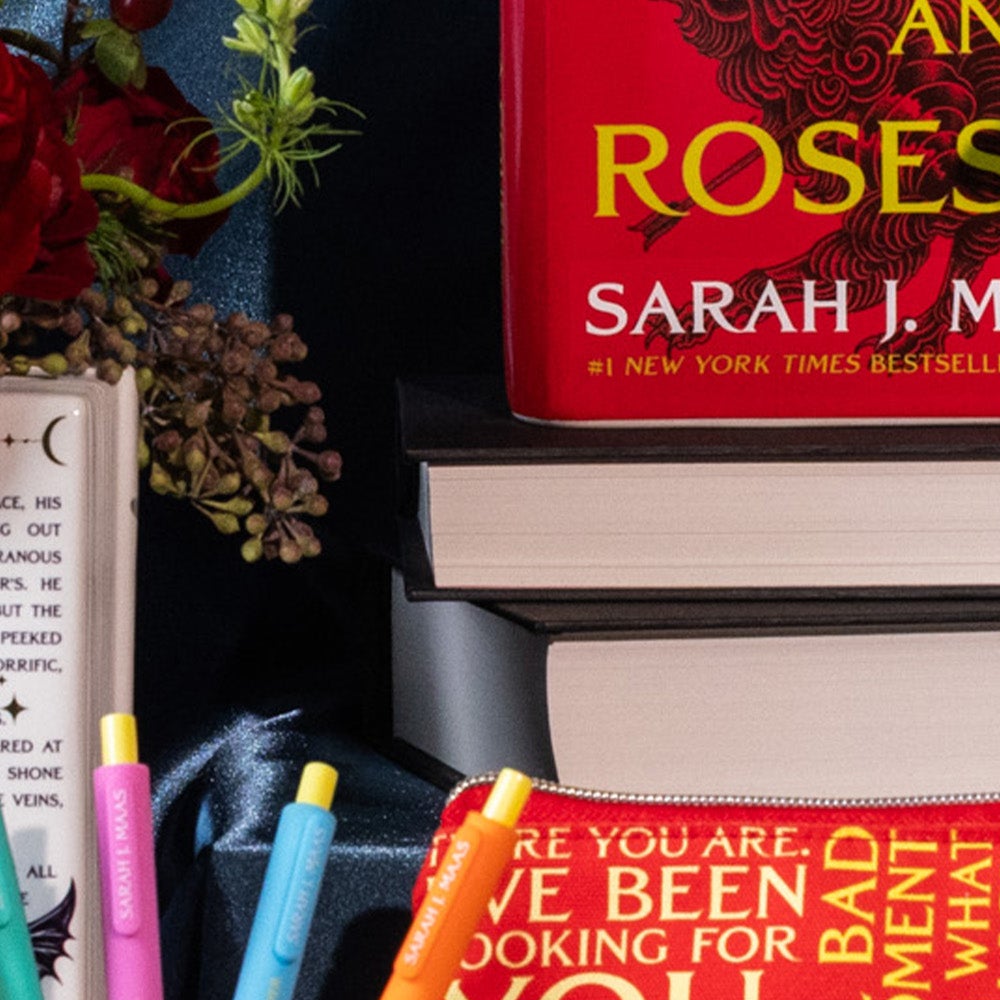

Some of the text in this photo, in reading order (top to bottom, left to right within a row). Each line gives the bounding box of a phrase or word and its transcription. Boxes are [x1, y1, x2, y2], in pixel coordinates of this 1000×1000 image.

[585, 280, 849, 336] SARAH
[879, 279, 917, 345] J.
[588, 357, 614, 376] #1
[625, 356, 685, 376] NEW
[696, 354, 771, 375] YORK
[784, 353, 862, 374] TIMES
[0, 496, 61, 511] CE, HIS
[27, 523, 61, 537] OUT
[41, 577, 62, 591] HE
[32, 604, 62, 618] THE
[42, 739, 62, 753] AT
[8, 766, 63, 780] SHONE
[13, 793, 64, 809] VEINS,
[113, 788, 130, 841] MAAS
[588, 826, 689, 859] YOU
[702, 826, 811, 859] ARE.
[26, 866, 57, 879] ALL
[404, 906, 439, 966] SARAH
[439, 840, 470, 891] MAAS
[605, 863, 808, 922] BEEN
[818, 825, 879, 964] BAD
[944, 828, 993, 981] WHAT
[461, 926, 802, 971] OOKING FOR
